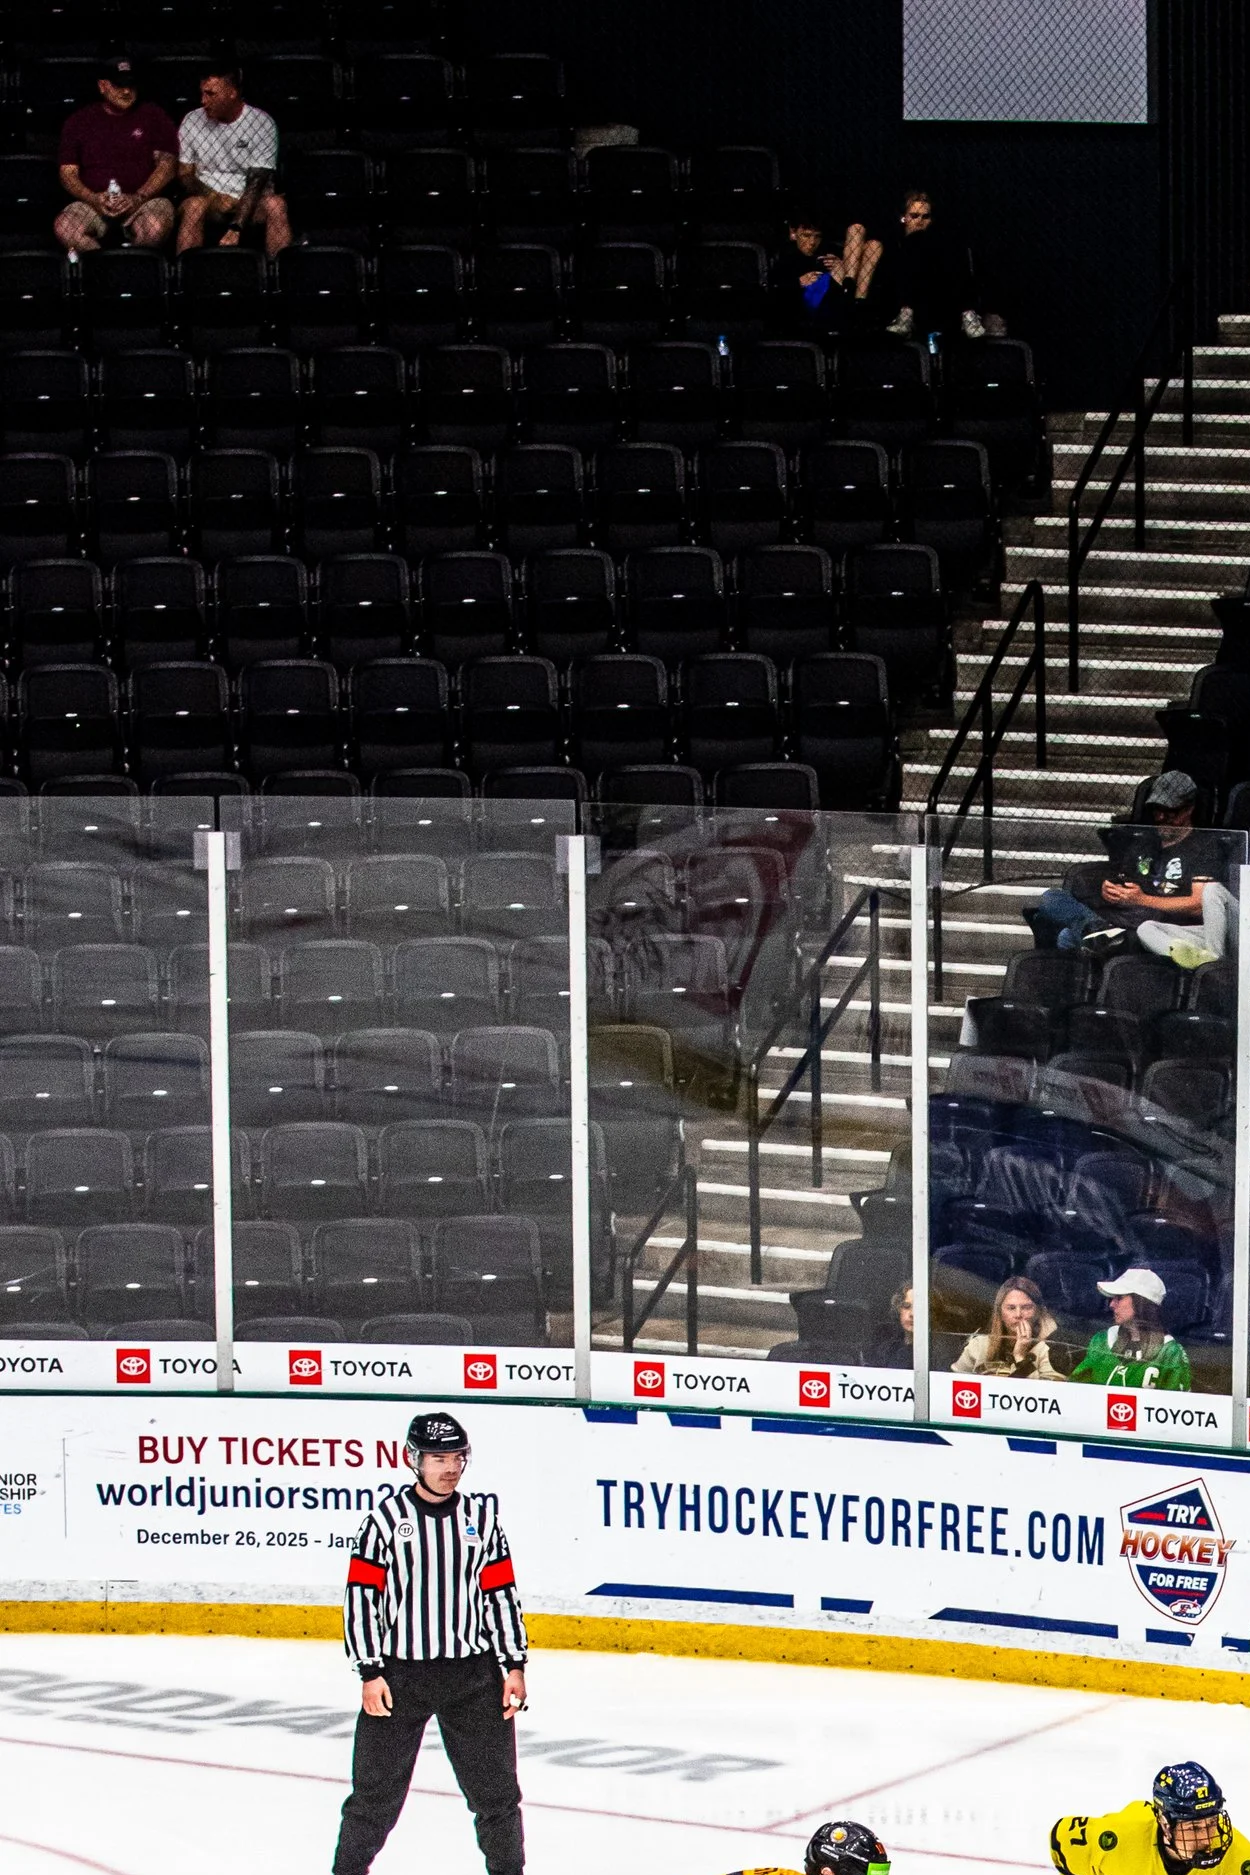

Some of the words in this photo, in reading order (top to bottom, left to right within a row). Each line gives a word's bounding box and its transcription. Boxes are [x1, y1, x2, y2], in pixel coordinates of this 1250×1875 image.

[159, 1359, 241, 1374] TOYOA
[330, 1361, 412, 1377] TOYOTA
[506, 1365, 575, 1380] TOYOT
[673, 1374, 750, 1392] TOYOTA
[989, 1394, 1061, 1414] TOYOTA
[1144, 1407, 1217, 1428] TOYOTA
[139, 1436, 207, 1464] BUY
[219, 1437, 363, 1467] TICKETS
[0, 1488, 36, 1500] SHIP
[0, 1503, 22, 1515] ES
[1166, 1504, 1201, 1525] TRY
[597, 1480, 1104, 1565] TRYHOCKEYFORFREE.COM
[138, 1529, 229, 1544] December
[236, 1531, 260, 1547] 26,
[267, 1532, 307, 1546] 2025
[1119, 1530, 1237, 1567] HOCKEY
[1149, 1573, 1174, 1588] FOR
[1176, 1576, 1208, 1591] FREE
[1195, 1786, 1209, 1799] 27
